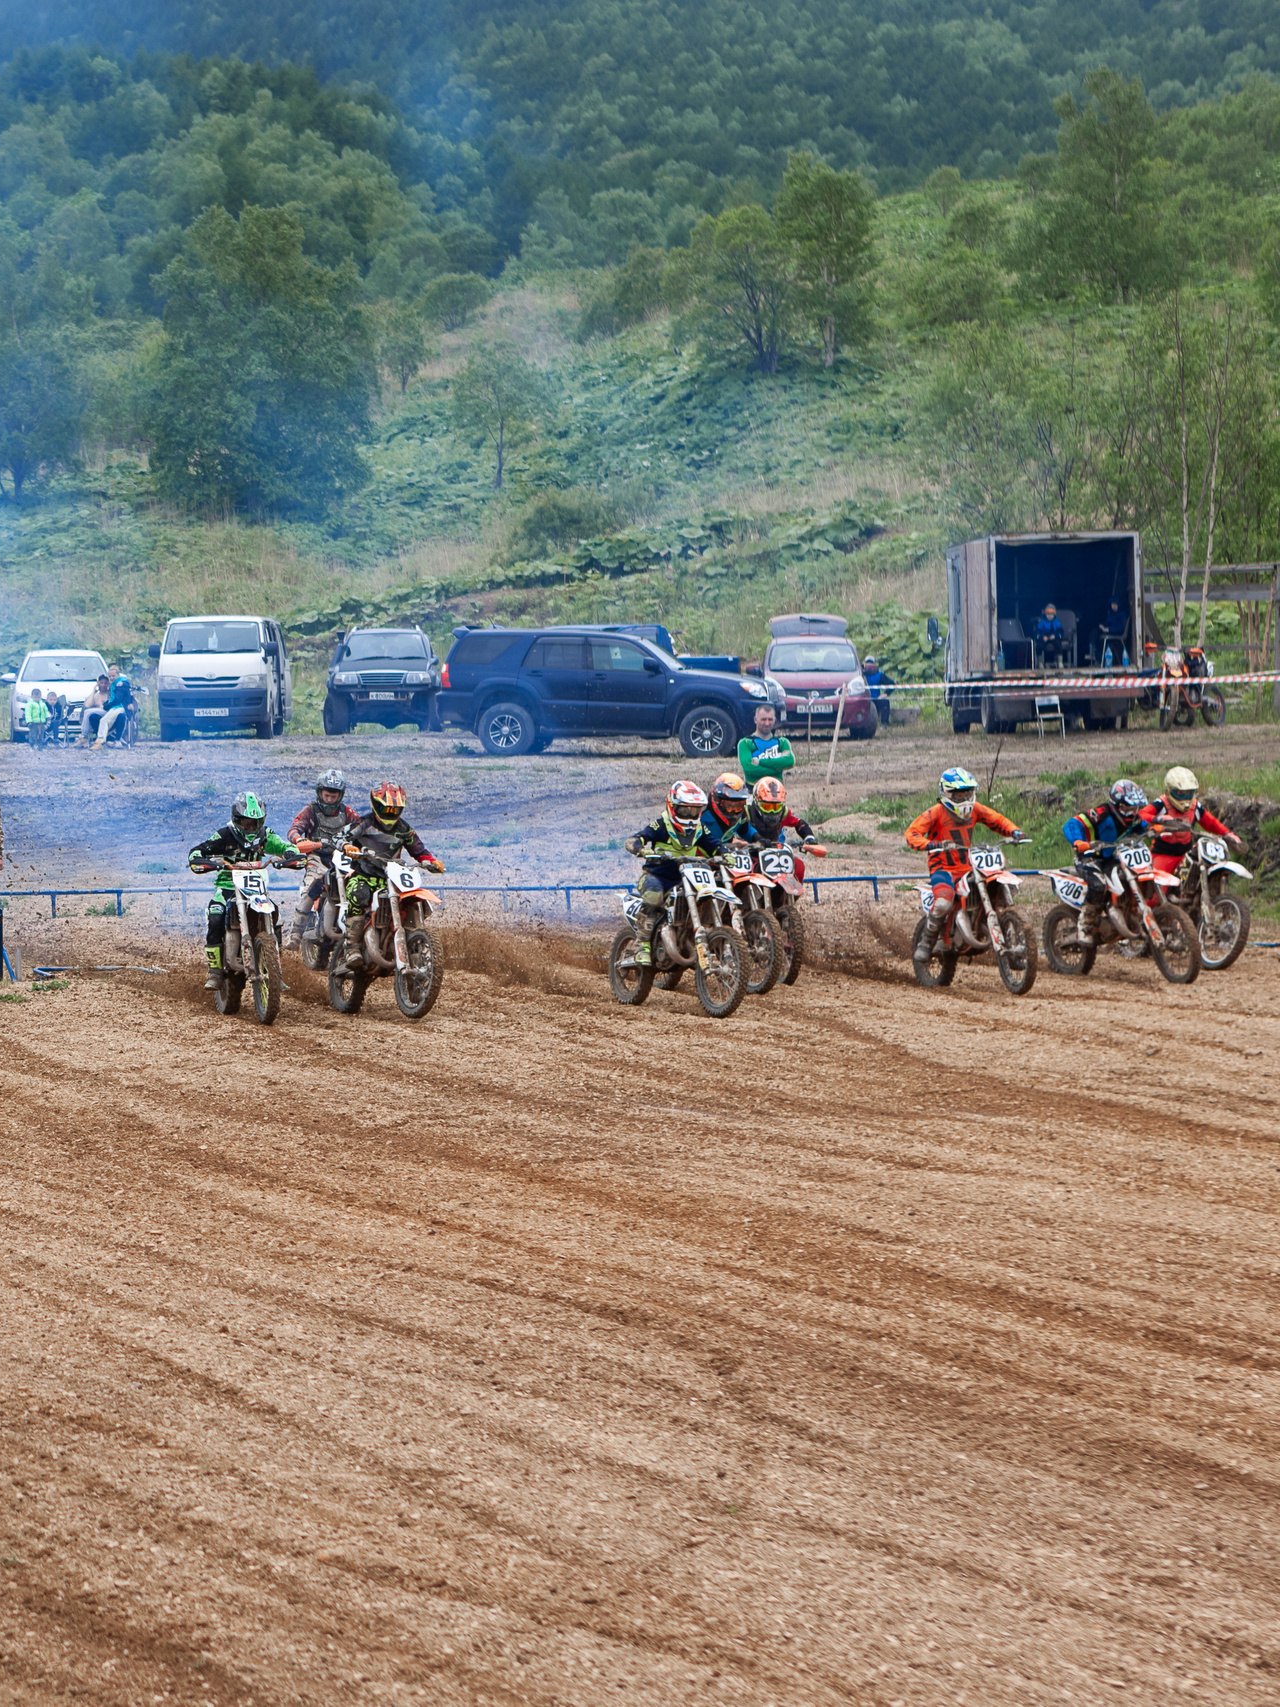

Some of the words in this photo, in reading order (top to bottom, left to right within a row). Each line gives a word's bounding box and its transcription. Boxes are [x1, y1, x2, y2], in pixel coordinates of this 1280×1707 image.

[1124, 848, 1151, 867] 206
[1206, 842, 1226, 860] 63
[730, 856, 751, 870] 03
[763, 854, 794, 873] 29
[974, 853, 1003, 869] 204
[243, 876, 261, 888] 15
[399, 873, 415, 888] 6
[693, 871, 711, 884] 60
[1060, 881, 1084, 900] 206
